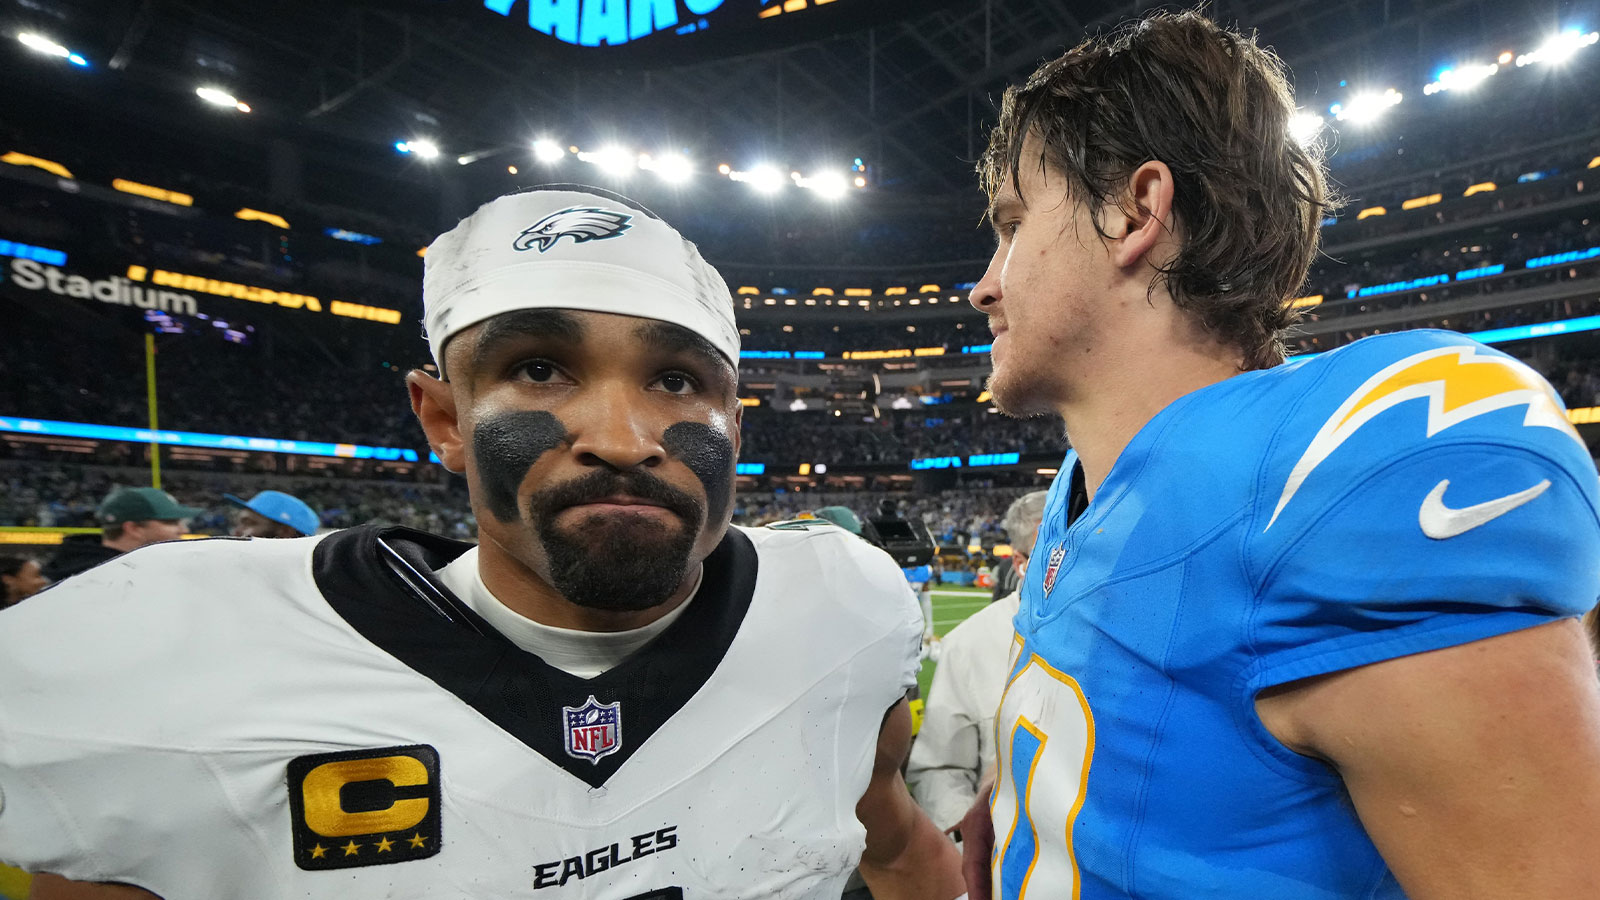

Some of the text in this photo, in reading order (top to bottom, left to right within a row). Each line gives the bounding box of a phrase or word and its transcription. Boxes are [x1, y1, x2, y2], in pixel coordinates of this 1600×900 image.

[11, 258, 198, 316] Stadium
[573, 726, 613, 752] NFL
[302, 755, 429, 837] C
[532, 825, 678, 890] EAGLES
